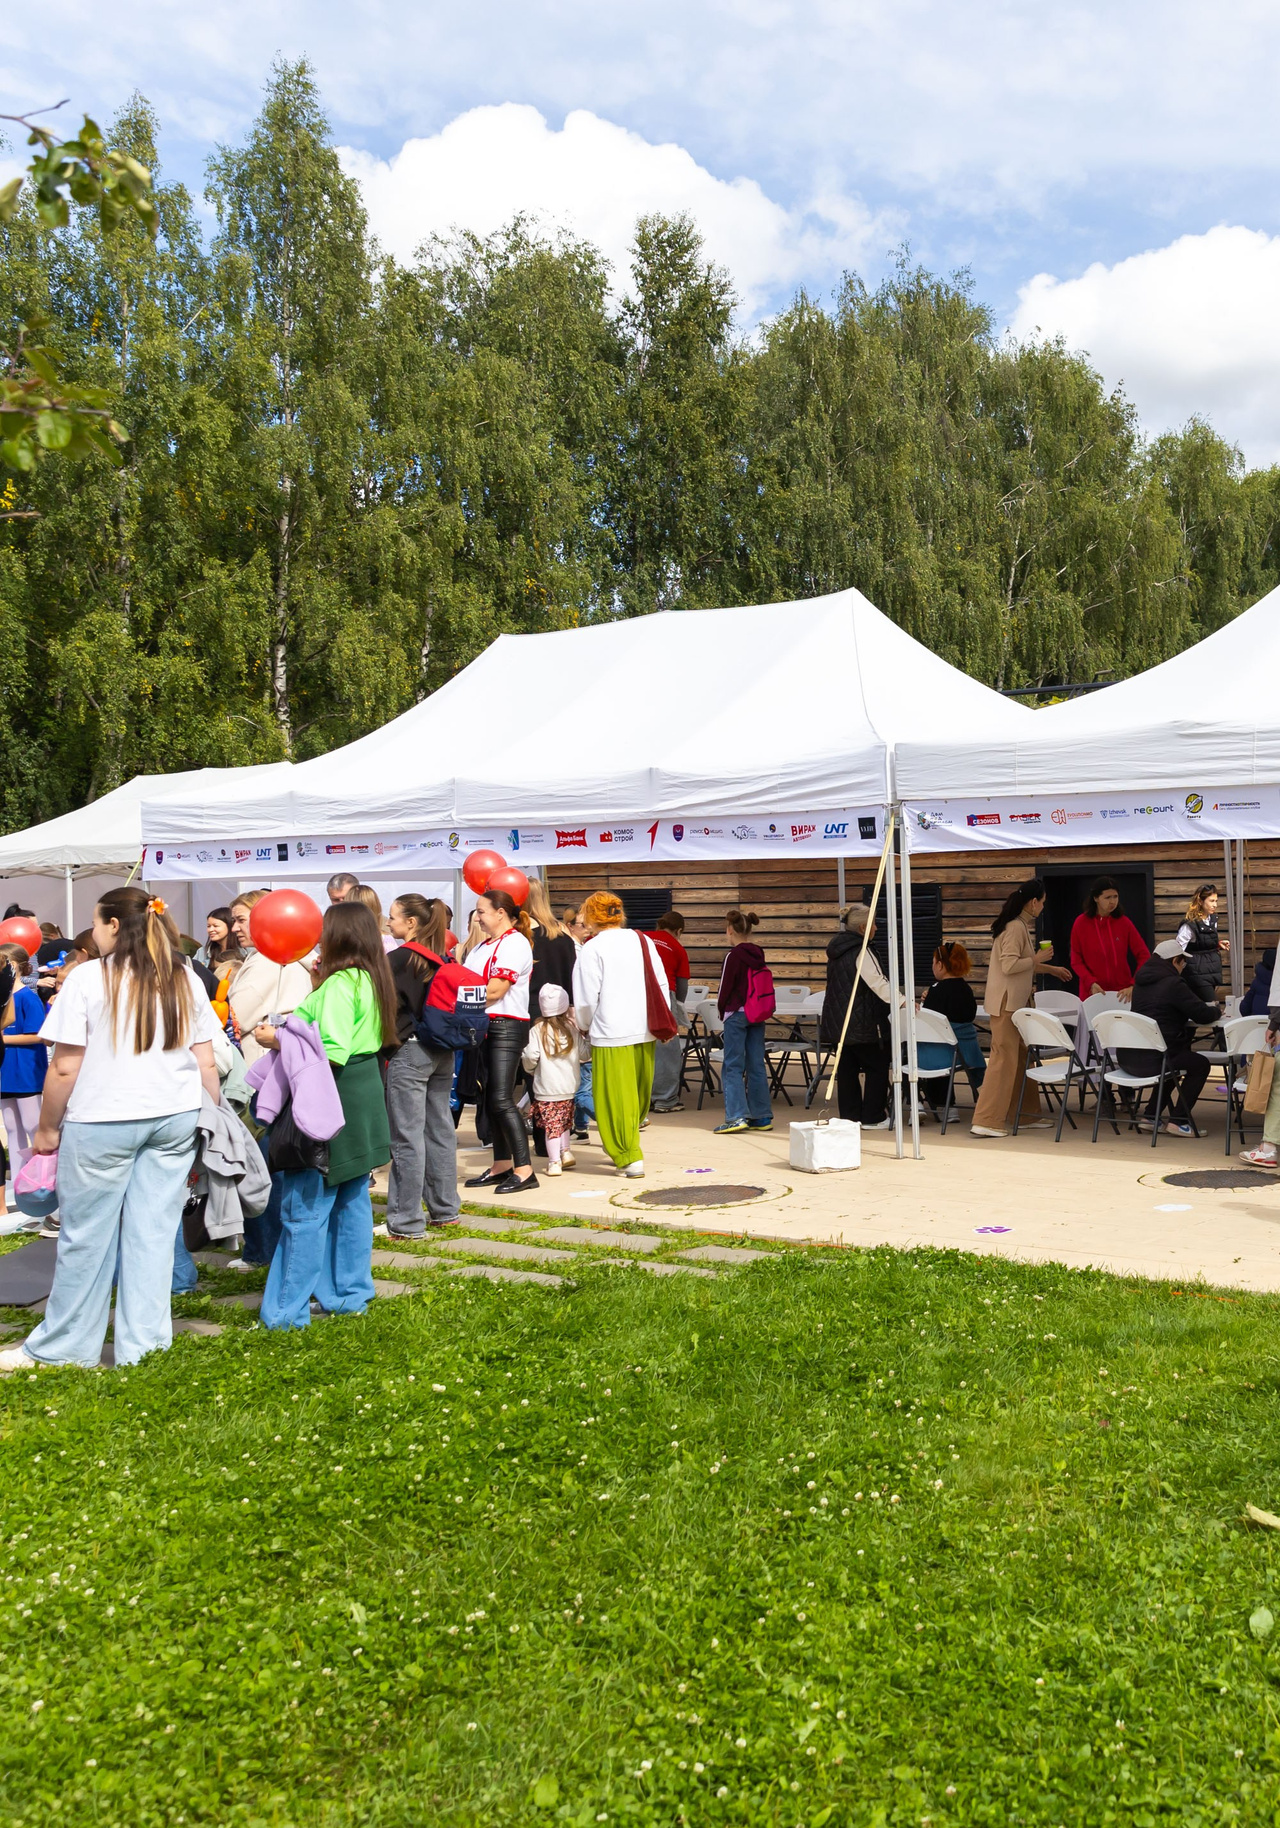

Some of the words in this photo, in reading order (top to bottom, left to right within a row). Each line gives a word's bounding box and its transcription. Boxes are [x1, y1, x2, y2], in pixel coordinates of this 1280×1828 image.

[1134, 805, 1174, 815] recourt
[791, 824, 816, 836] ВИРАЖ
[824, 823, 849, 834] UNT
[257, 848, 272, 857] UNT
